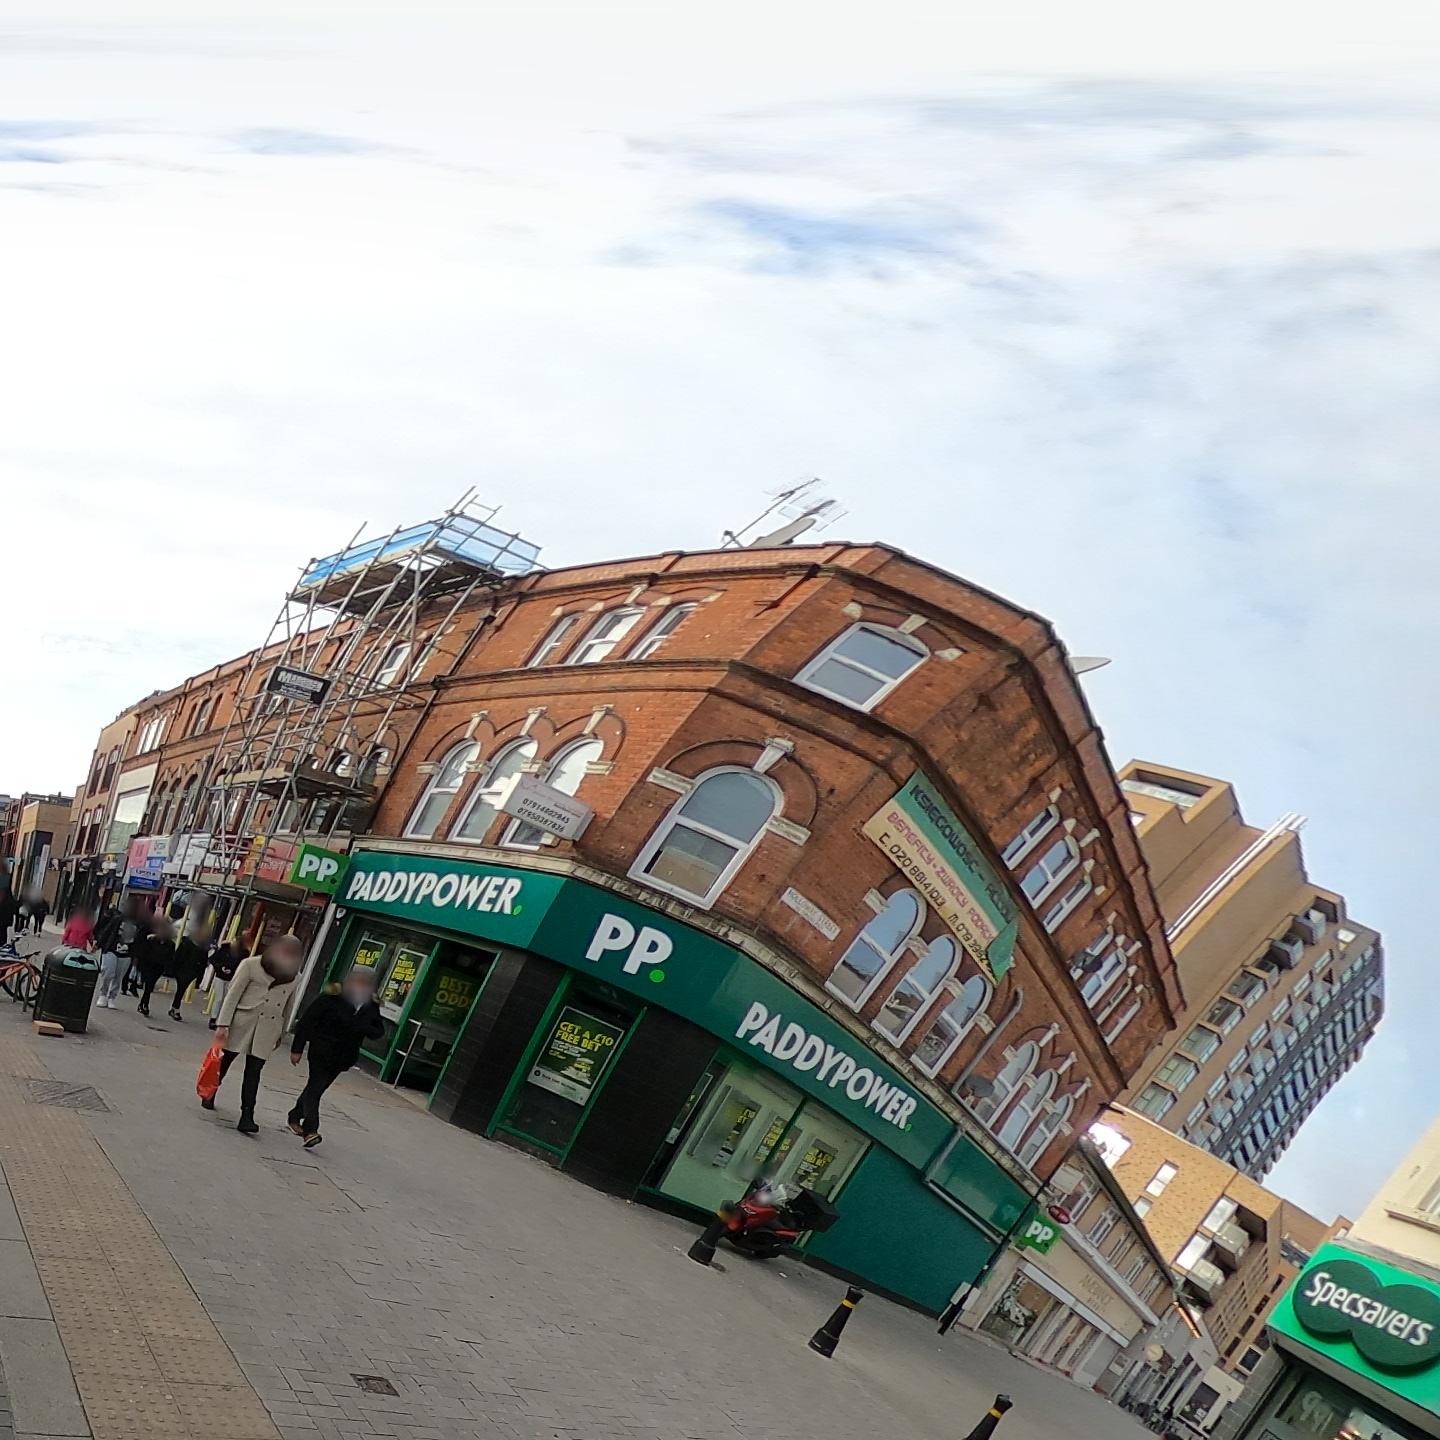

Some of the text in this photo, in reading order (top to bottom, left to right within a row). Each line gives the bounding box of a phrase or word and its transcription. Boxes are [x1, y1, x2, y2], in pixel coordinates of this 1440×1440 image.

[298, 854, 338, 882] PP
[889, 843, 912, 867] 020
[346, 871, 522, 915] PADDYPOWER
[585, 912, 673, 976] PP
[555, 1029, 581, 1045] FREE
[581, 1038, 602, 1053] BET
[560, 1021, 582, 1035] GET
[582, 1030, 590, 1040] A
[735, 1001, 915, 1130] PADDYPOWER
[1025, 1220, 1054, 1243] PP
[1305, 1271, 1436, 1346] Specsavers
